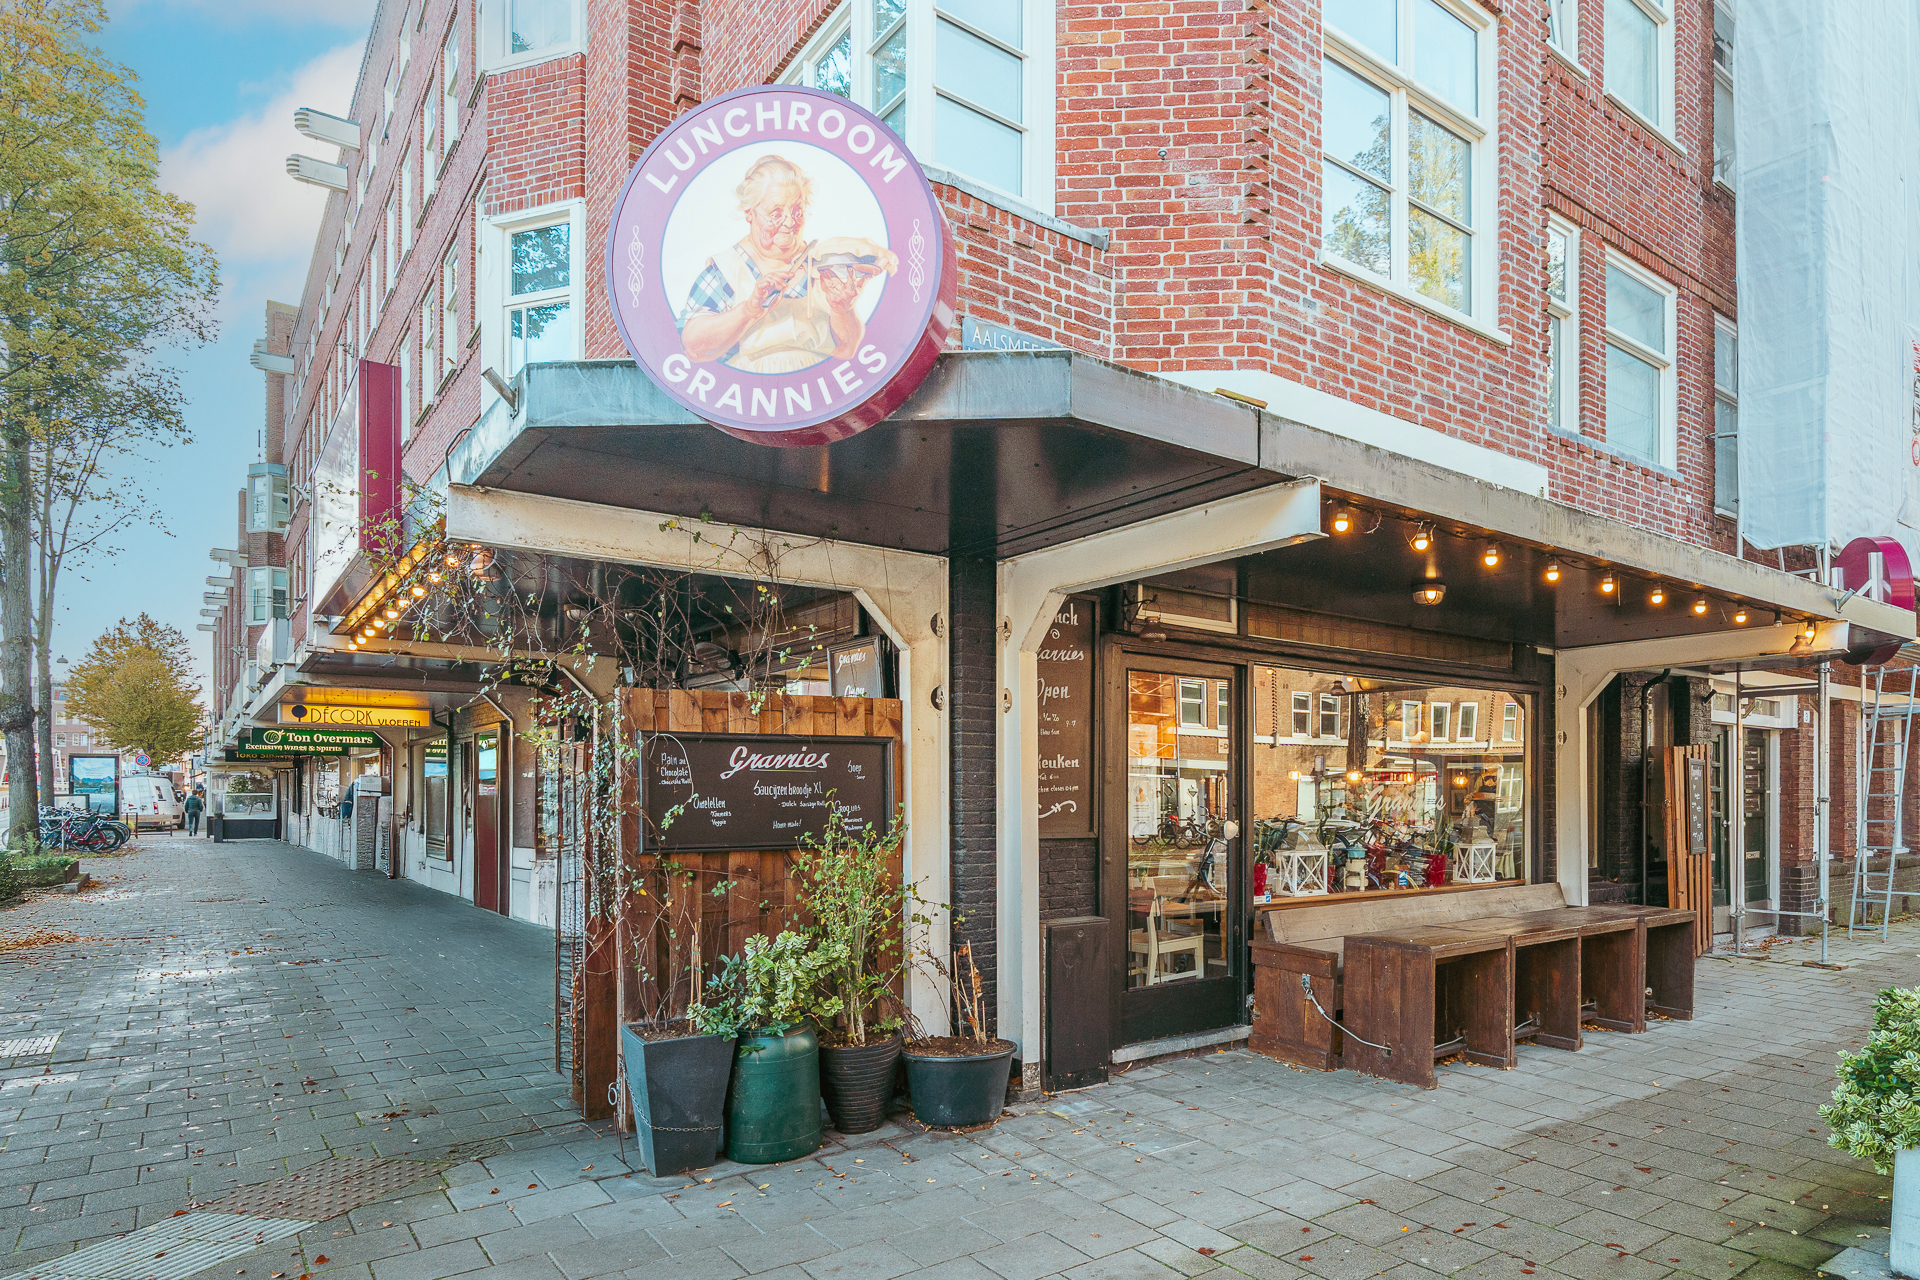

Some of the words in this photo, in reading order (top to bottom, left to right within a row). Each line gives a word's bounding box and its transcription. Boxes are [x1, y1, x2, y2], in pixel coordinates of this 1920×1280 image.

[645, 100, 907, 194] LUNCHROOM
[662, 344, 888, 418] GRANNIES
[310, 706, 373, 726] DÉCORK
[377, 718, 421, 727] VLOEREN
[286, 732, 311, 743] Ton
[313, 733, 373, 744] Overmars
[661, 752, 678, 765] Pain
[720, 746, 830, 779] Grannies
[1373, 767, 1439, 783] Lunchroom
[813, 781, 824, 794] XL
